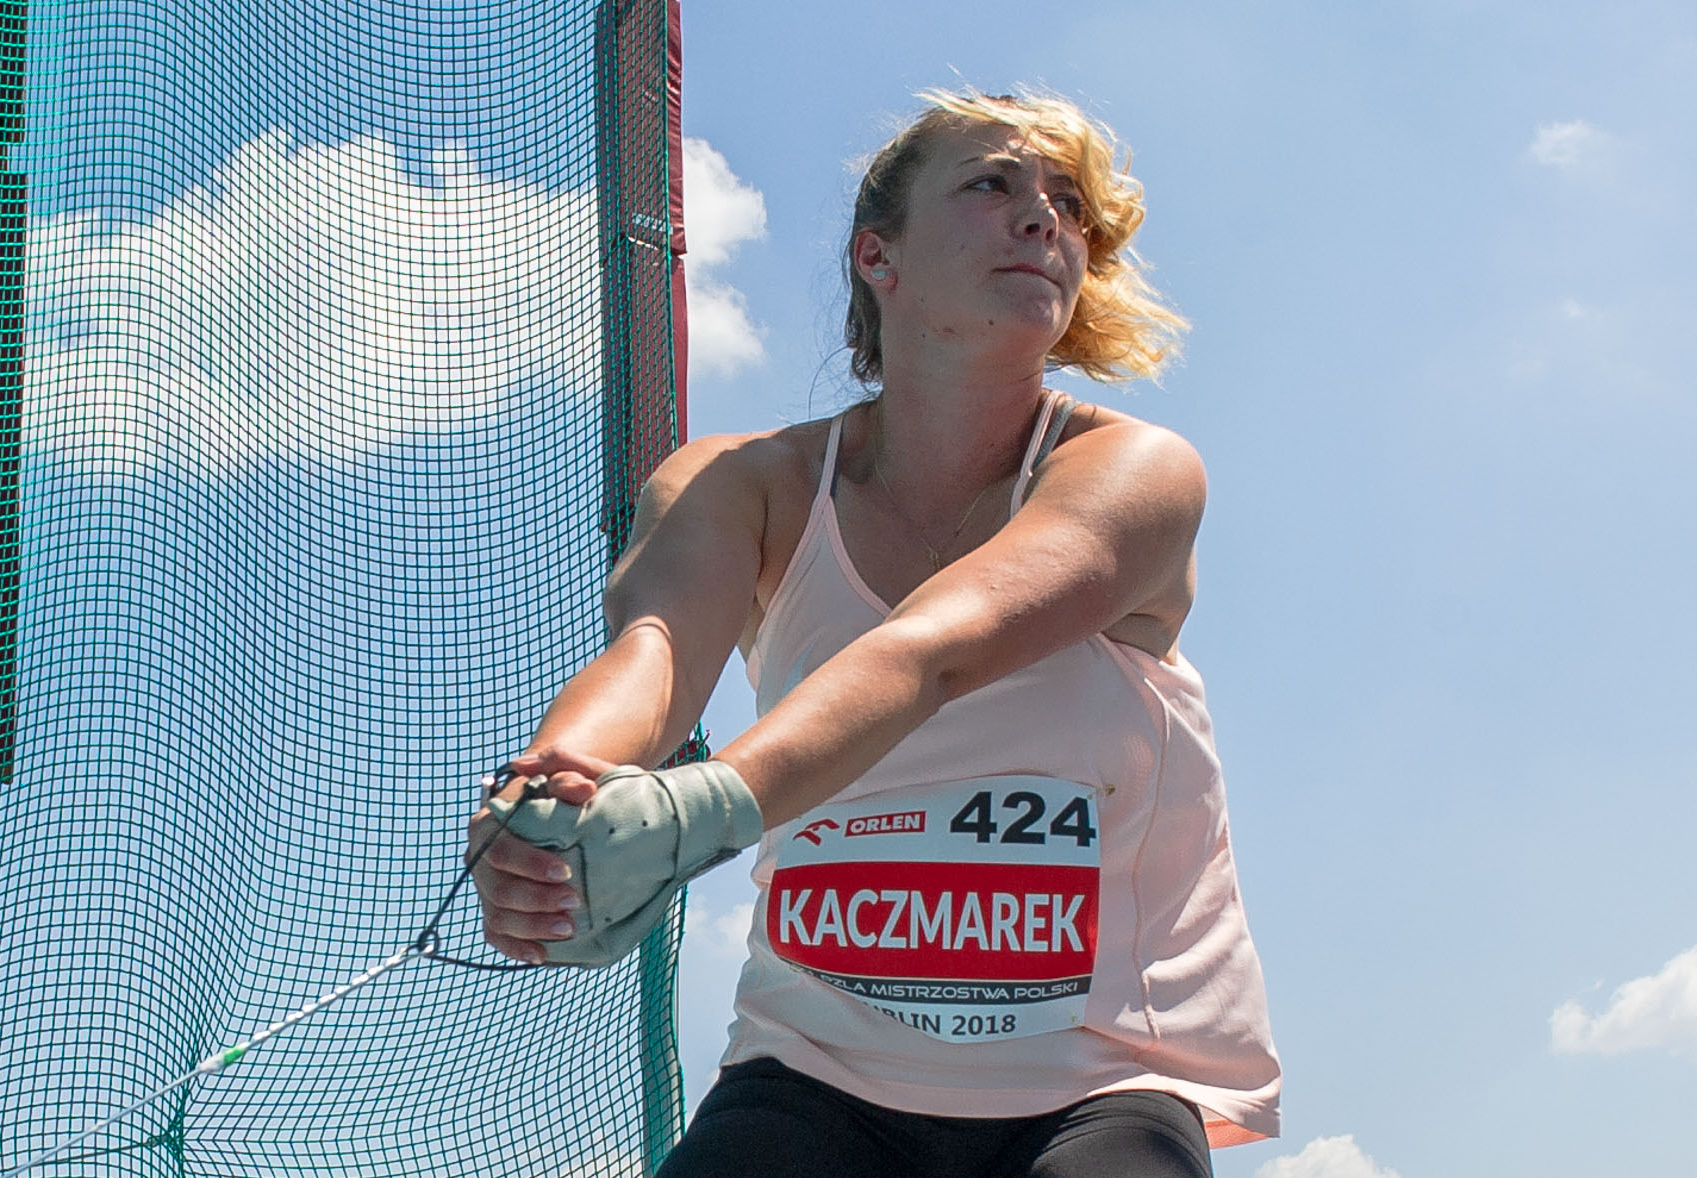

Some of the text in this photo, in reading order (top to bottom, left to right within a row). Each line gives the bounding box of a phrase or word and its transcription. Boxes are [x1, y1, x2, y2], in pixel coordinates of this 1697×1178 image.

[849, 813, 921, 834] ORLEN
[949, 790, 1097, 848] 424
[778, 888, 1085, 952] KACZMAREK
[870, 983, 1011, 1000] MISTRZOSTWA
[1014, 981, 1079, 999] POLSKI
[951, 1014, 1017, 1036] 2018
